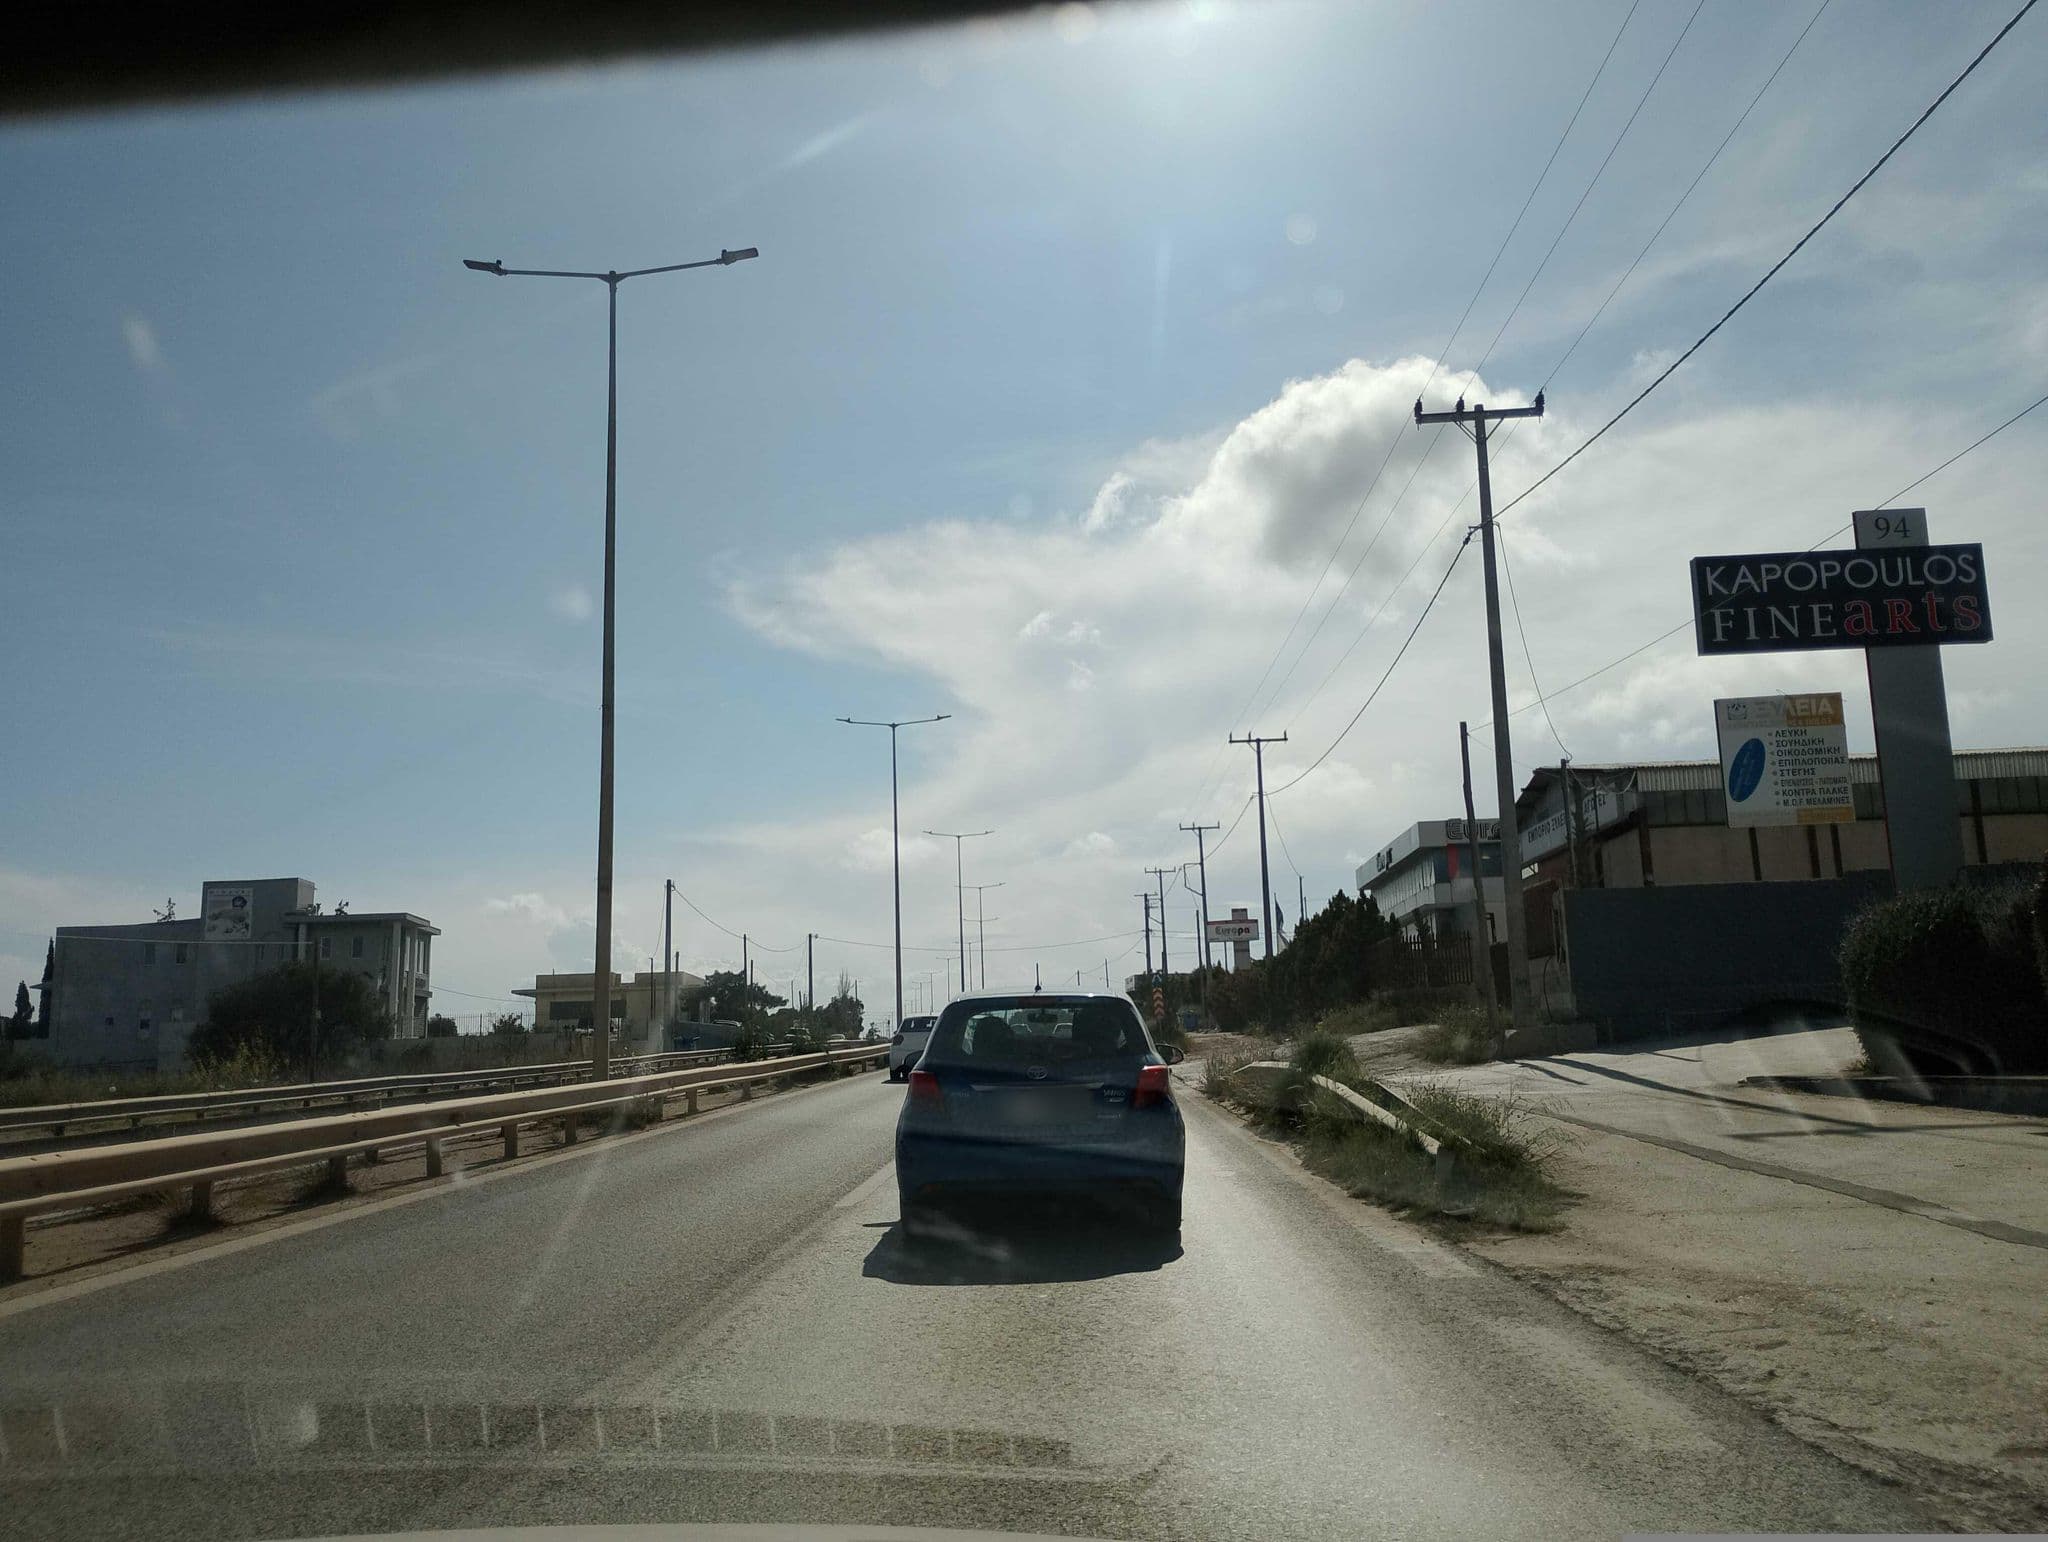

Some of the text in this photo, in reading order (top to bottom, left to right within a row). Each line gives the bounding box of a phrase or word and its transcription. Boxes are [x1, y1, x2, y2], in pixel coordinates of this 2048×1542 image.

[1875, 516, 1911, 540] 94
[1706, 554, 1977, 596] KAPOPOULOS
[1710, 603, 1838, 642] FINE
[1775, 729, 1807, 738] ΛΕΥΚΗ
[1775, 738, 1825, 748] ΣΟΥΗΔΙΚΗ
[1777, 746, 1841, 757] ΟΙΚΟΔΟΜΙΚΗ
[1780, 768, 1816, 777] ΣΤΕΓΗΣ
[1782, 788, 1816, 797] ΚΟΝΤΡΑ
